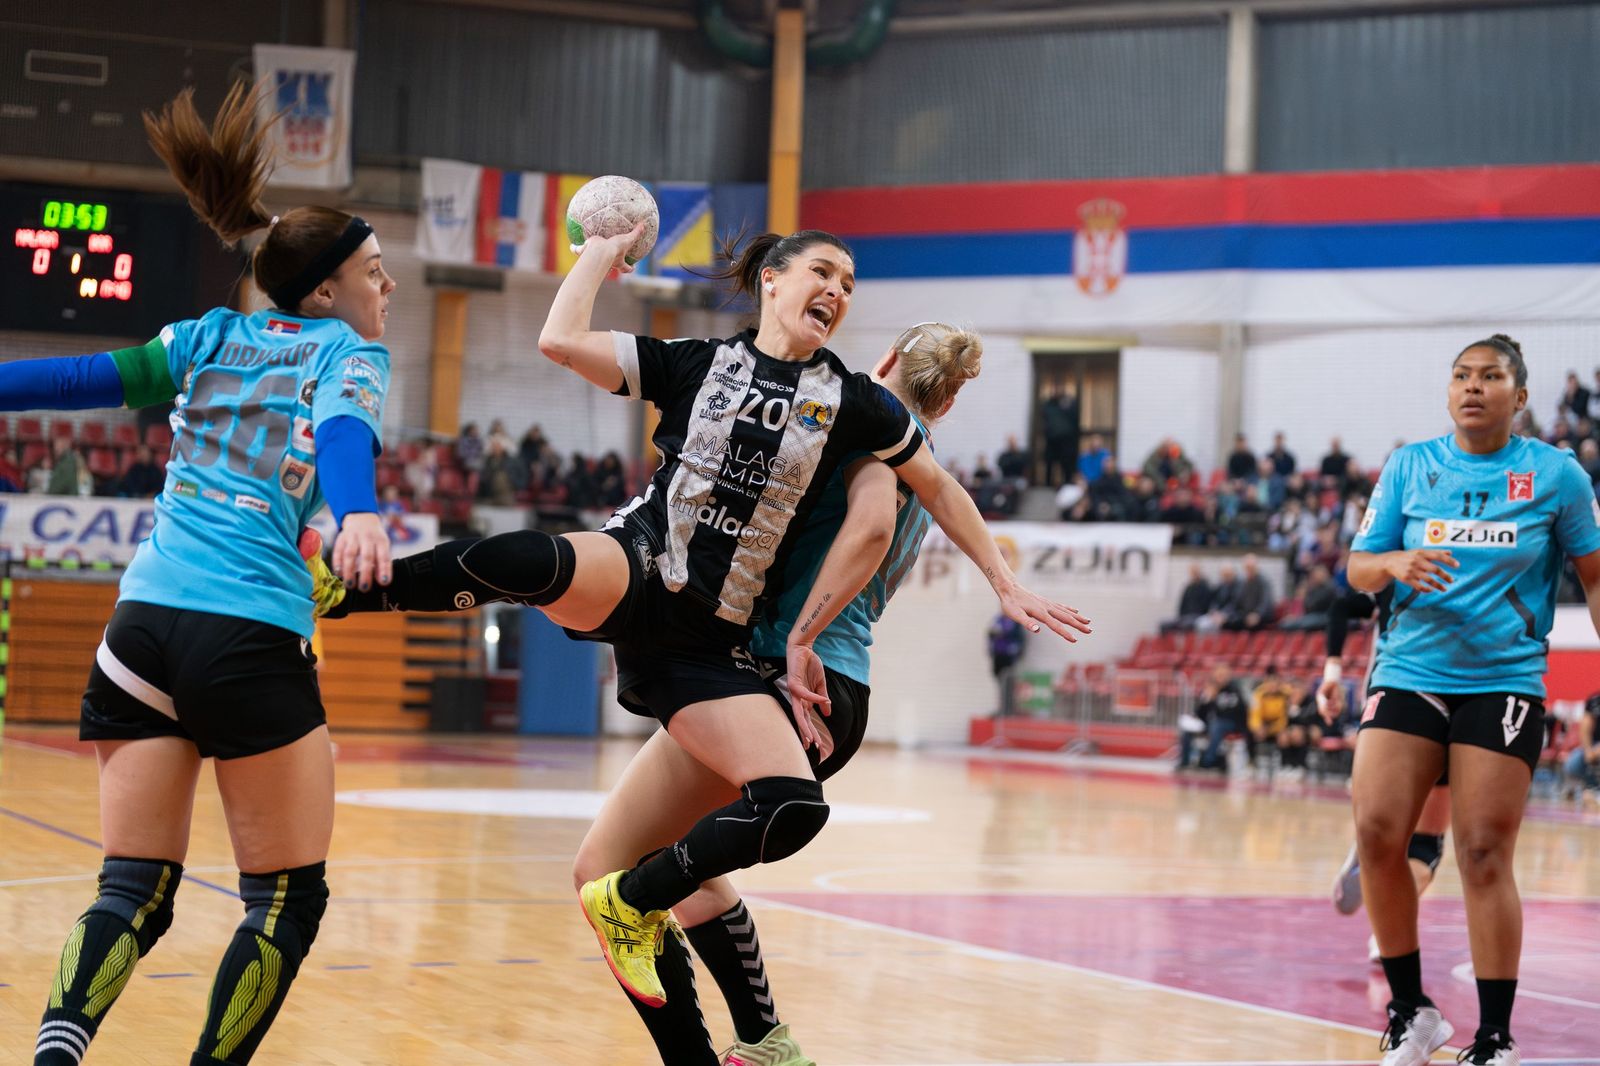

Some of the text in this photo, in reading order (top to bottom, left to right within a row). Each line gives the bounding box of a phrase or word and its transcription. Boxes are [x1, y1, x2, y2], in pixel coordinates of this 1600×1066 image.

[32, 248, 50, 275] 0
[115, 253, 133, 281] 0
[737, 388, 790, 432] 20
[695, 432, 801, 483] MÁLAGA
[680, 452, 803, 504] COMPITE
[701, 472, 746, 494] PROVINCIA
[746, 490, 758, 500] EN
[759, 496, 786, 513] FORMA
[1461, 491, 1489, 517] 17
[1502, 695, 1530, 730] 17
